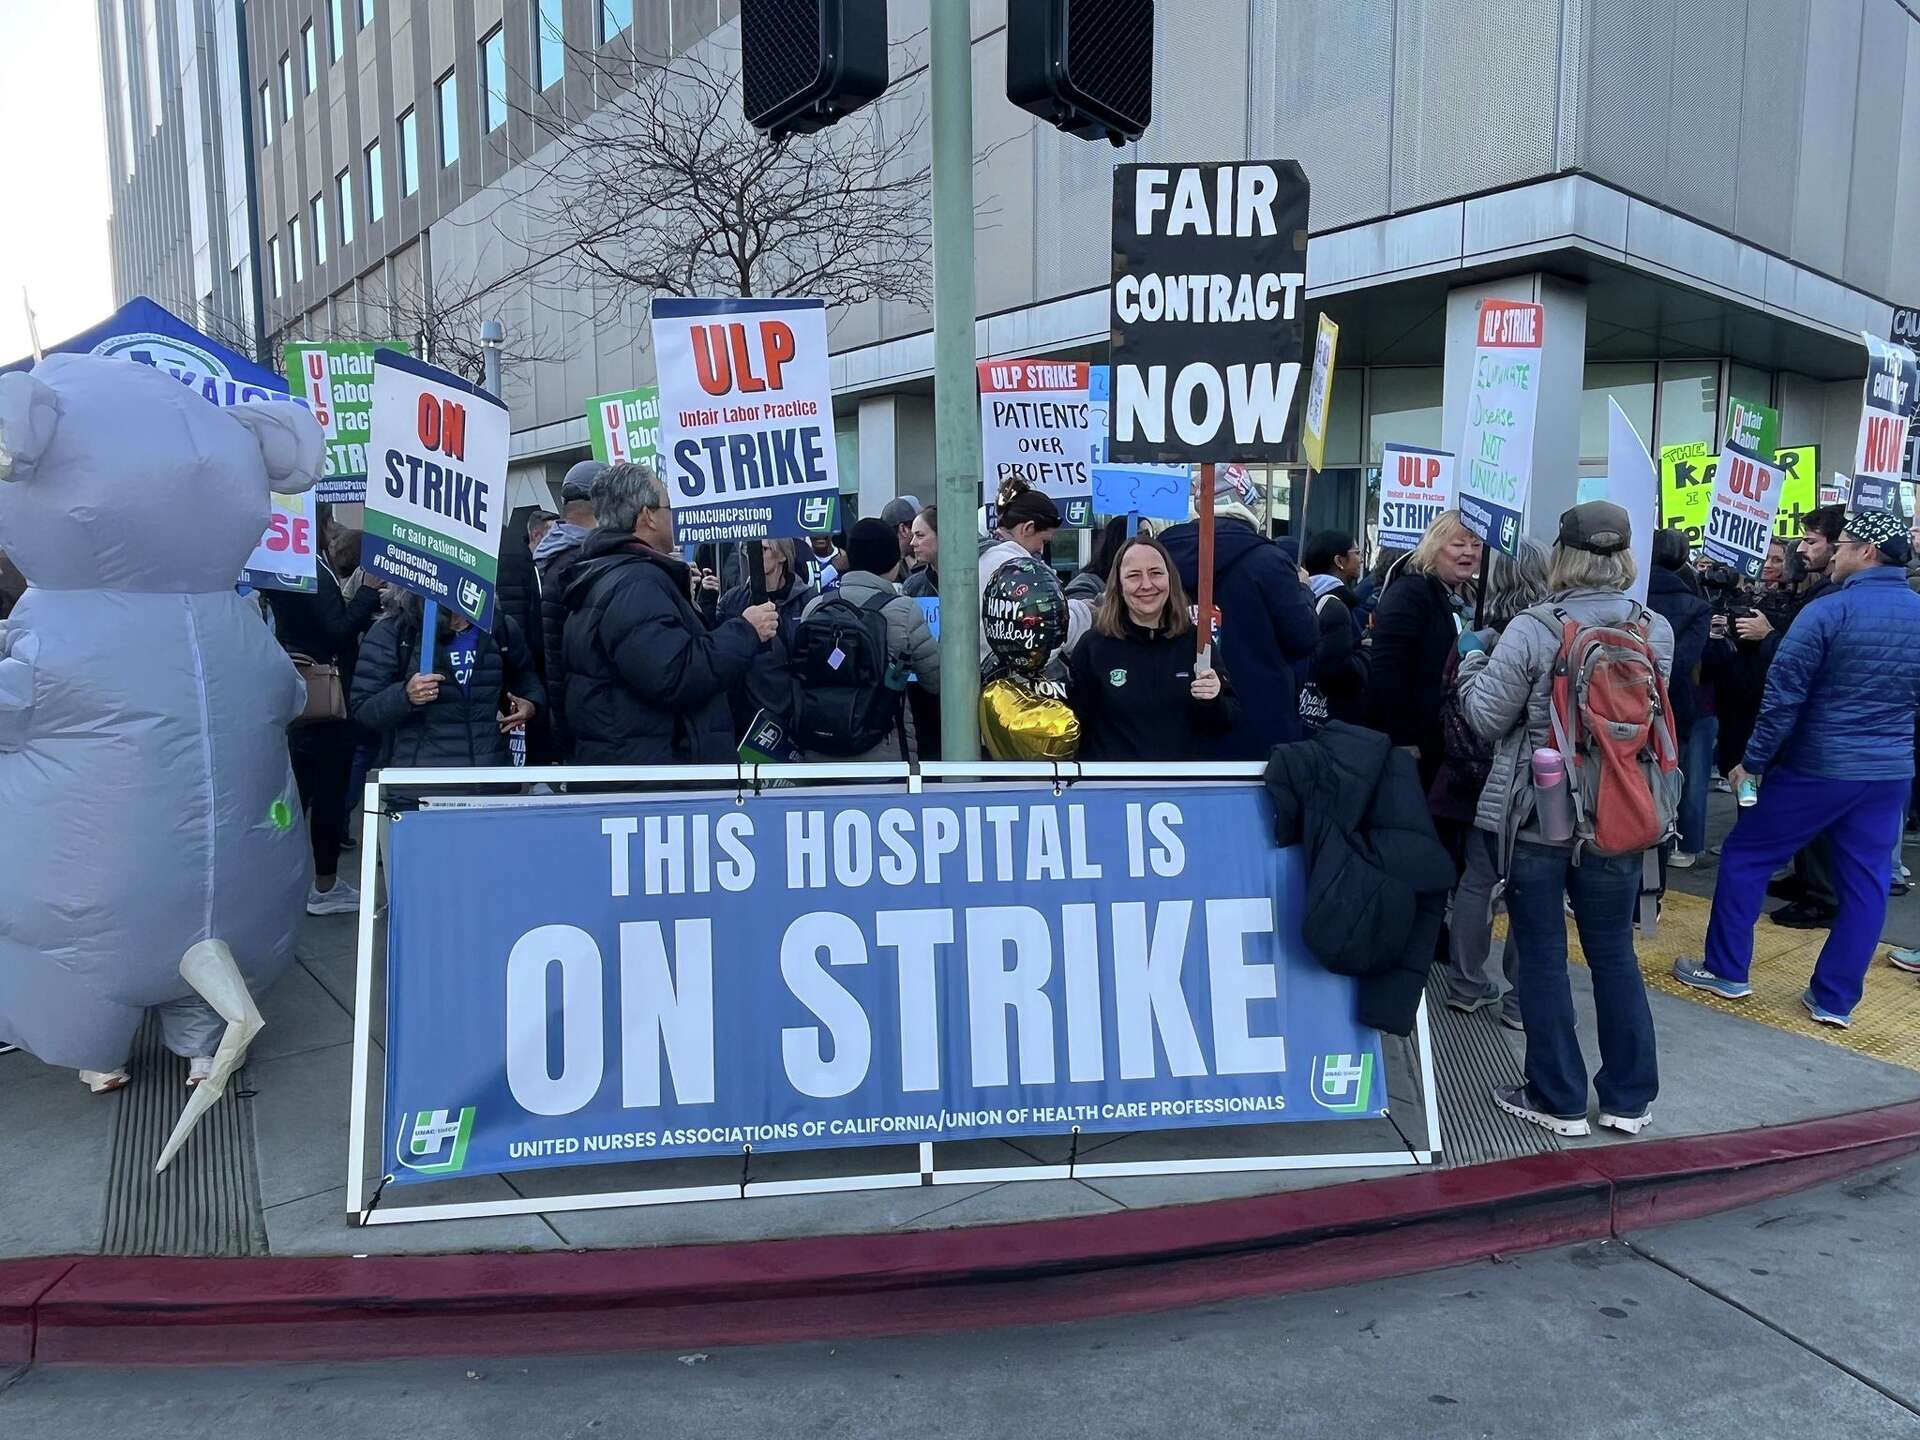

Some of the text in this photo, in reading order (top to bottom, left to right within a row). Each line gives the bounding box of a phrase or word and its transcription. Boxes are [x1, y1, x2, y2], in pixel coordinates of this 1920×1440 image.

[1134, 165, 1279, 237] FAIR
[1115, 272, 1305, 324] CONTRACT
[1484, 308, 1536, 343] ULP STRIKE
[690, 320, 796, 397] ULP
[990, 364, 1078, 389] ULP STRIKE
[679, 399, 817, 428] Unfair Labor Practice
[993, 401, 1089, 429] PATIENTS
[1115, 361, 1302, 447] NOW
[417, 391, 466, 462] ON
[1018, 437, 1065, 455] OVER
[1481, 431, 1506, 461] NOT
[1864, 416, 1904, 473] NOW
[673, 426, 828, 498] STRIKE
[997, 461, 1087, 486] PROFITS
[1398, 456, 1440, 488] ULP
[1663, 443, 1706, 463] THE
[385, 448, 489, 534] STRIKE
[1729, 456, 1771, 503] ULP
[258, 512, 310, 555] SE
[677, 506, 772, 526] #UNACUHCPstrong
[678, 522, 768, 543] #TogetherWeWin
[1710, 506, 1768, 554] STRIKE
[386, 543, 438, 577] @unacuhcp
[392, 523, 477, 567] For Safe Patient Care
[373, 553, 449, 597] #TogetherWeRise
[988, 598, 1020, 622] HAPPY
[601, 801, 1187, 897] THIS HOSPITAL IS
[505, 897, 1286, 1116] ON STRIKE
[509, 1095, 1286, 1159] UNITED NURSES ASSOCIATIONS OF CALIFORNIA/UNION OF HEALTH CARE PROFESSIONALS
